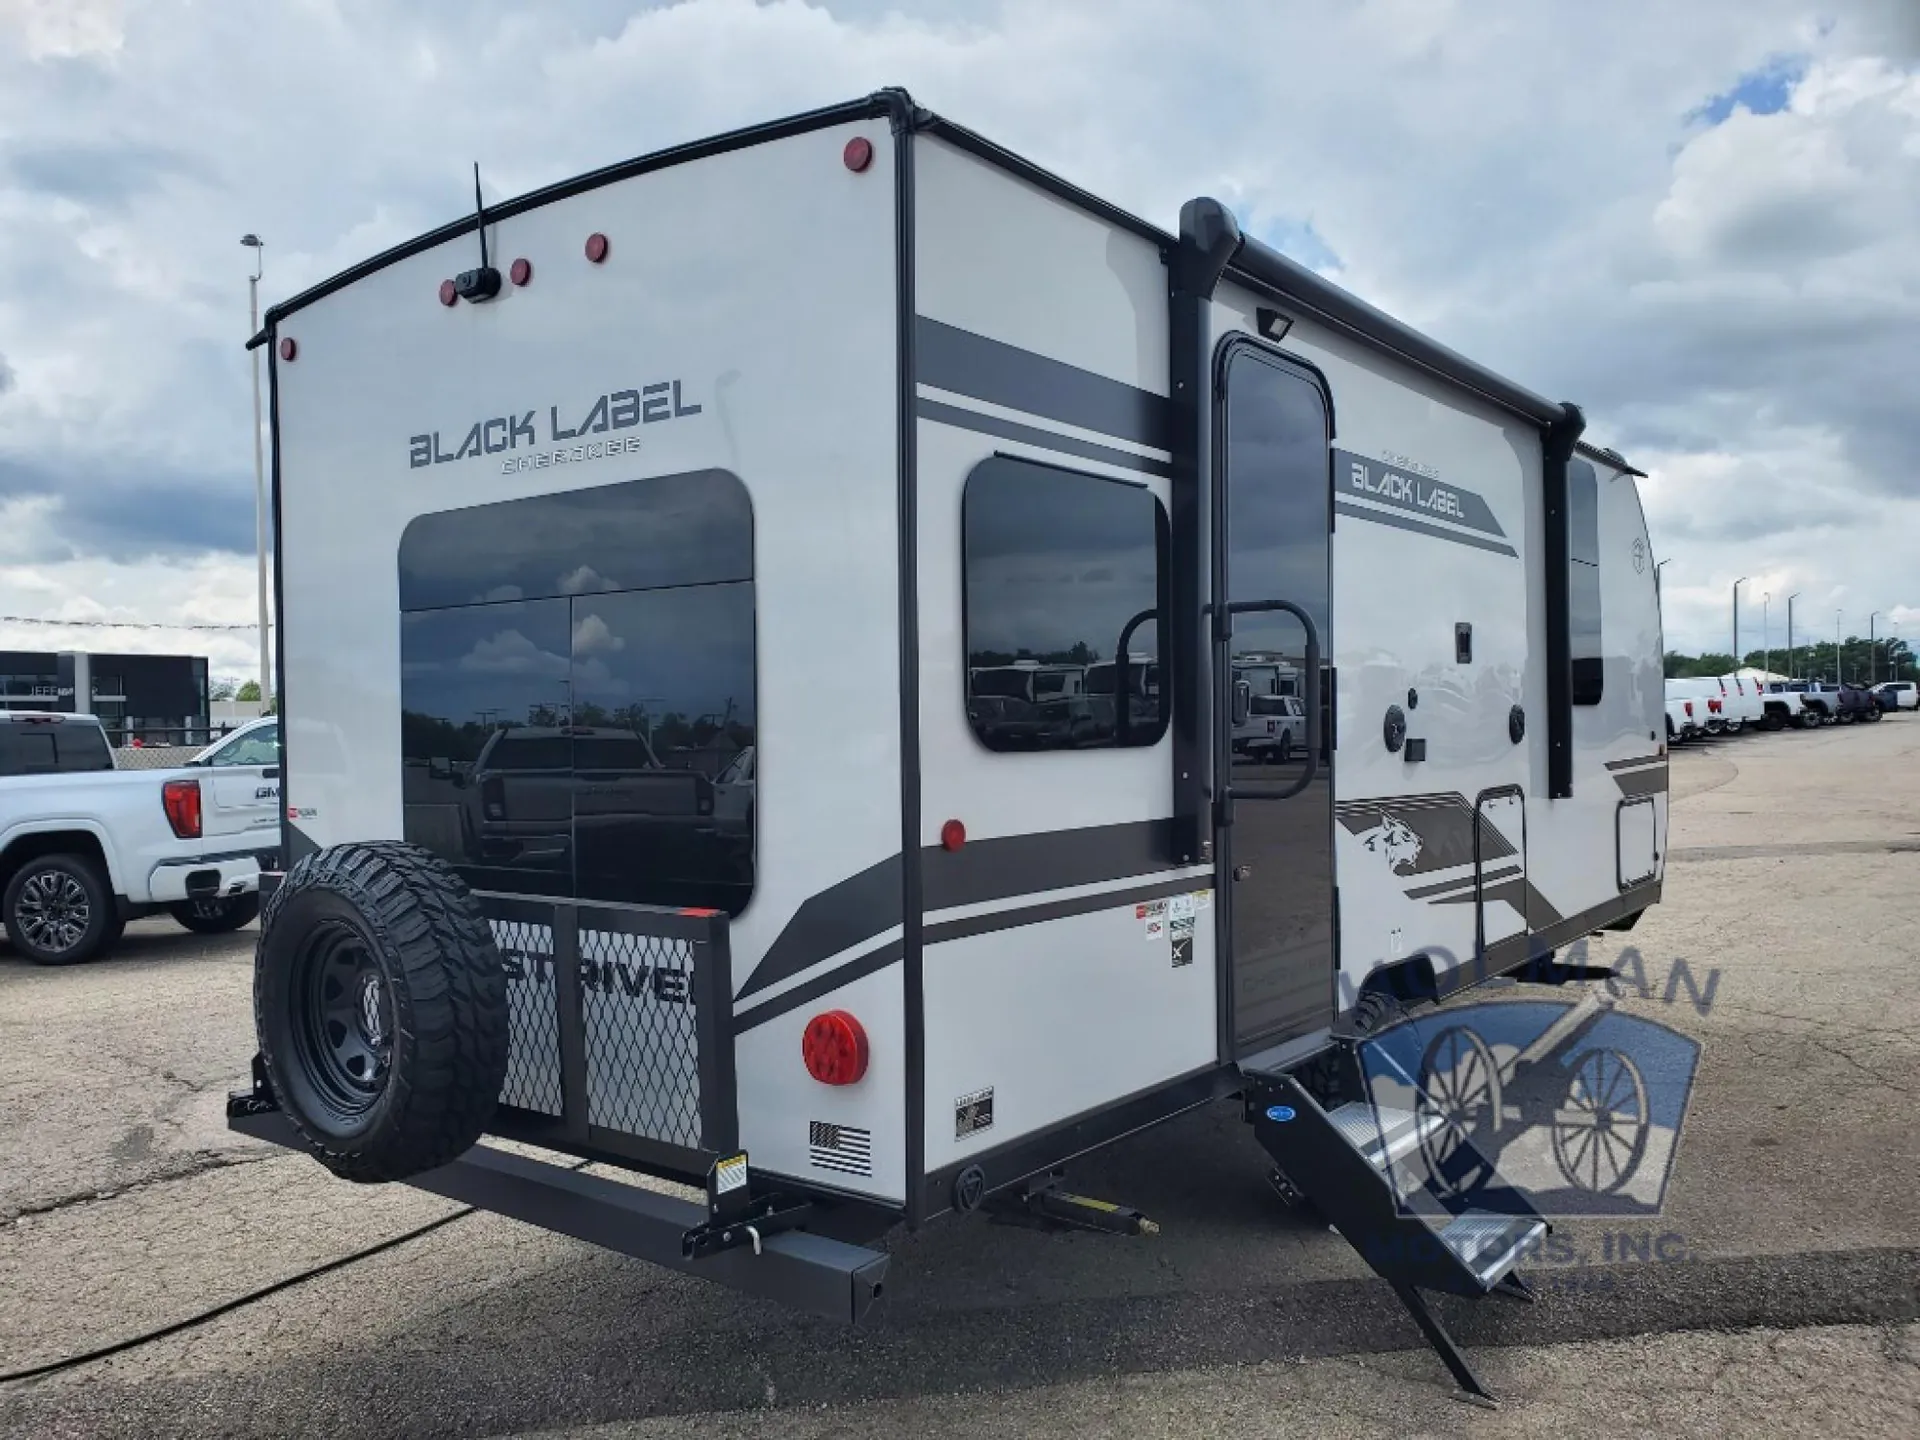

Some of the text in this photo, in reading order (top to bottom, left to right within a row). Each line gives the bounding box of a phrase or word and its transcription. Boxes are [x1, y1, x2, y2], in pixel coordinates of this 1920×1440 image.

[409, 379, 702, 468] BLACK LABEL
[501, 436, 640, 475] CHEROKEE
[1351, 462, 1465, 518] BLACK LABEL
[255, 787, 280, 799] GM
